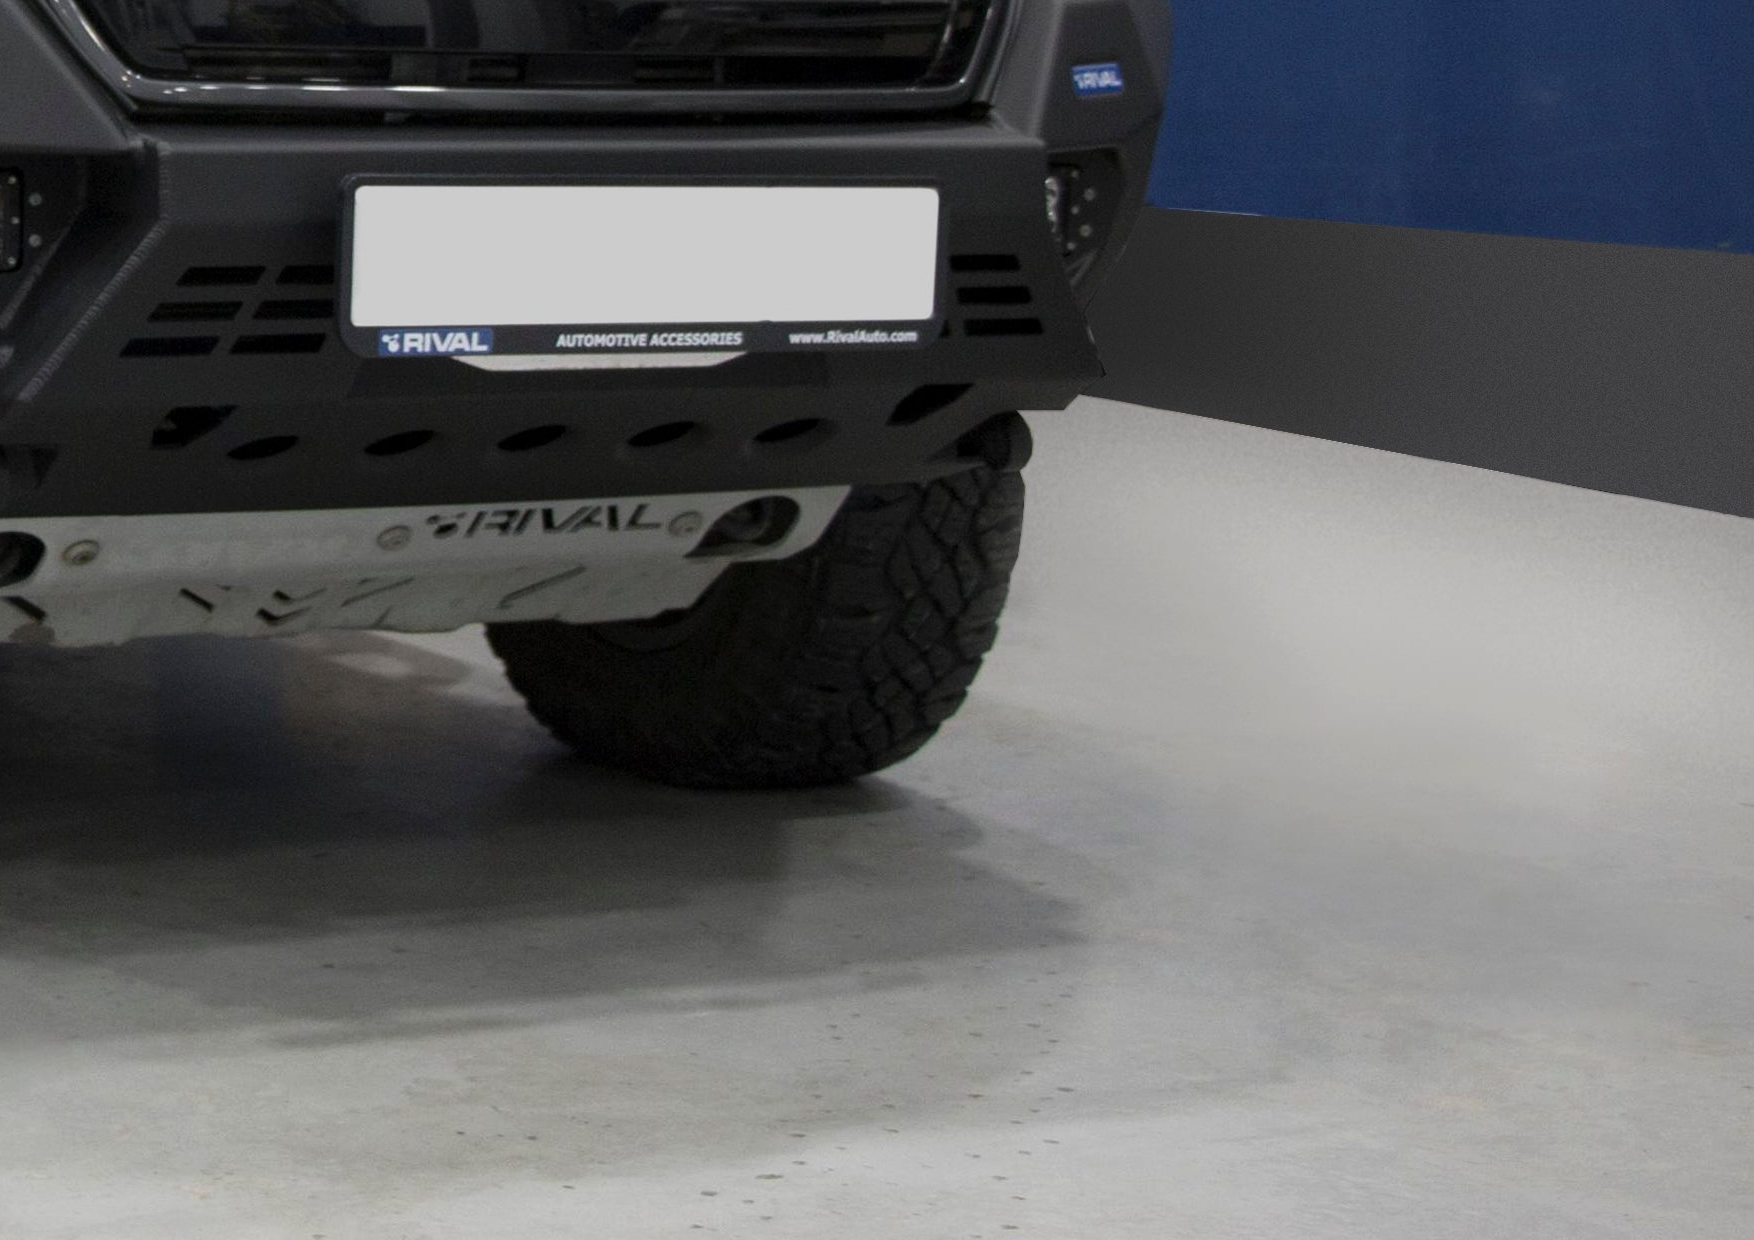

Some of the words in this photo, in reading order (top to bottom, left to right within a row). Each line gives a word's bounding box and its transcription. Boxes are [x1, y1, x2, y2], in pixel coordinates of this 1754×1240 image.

[402, 332, 489, 353] RIVAL
[556, 333, 647, 348] AUTOMOTIVE
[649, 331, 743, 346] ACCESSORIES
[788, 329, 918, 345] www.RivalAuto.com
[463, 503, 662, 538] RIVAL
